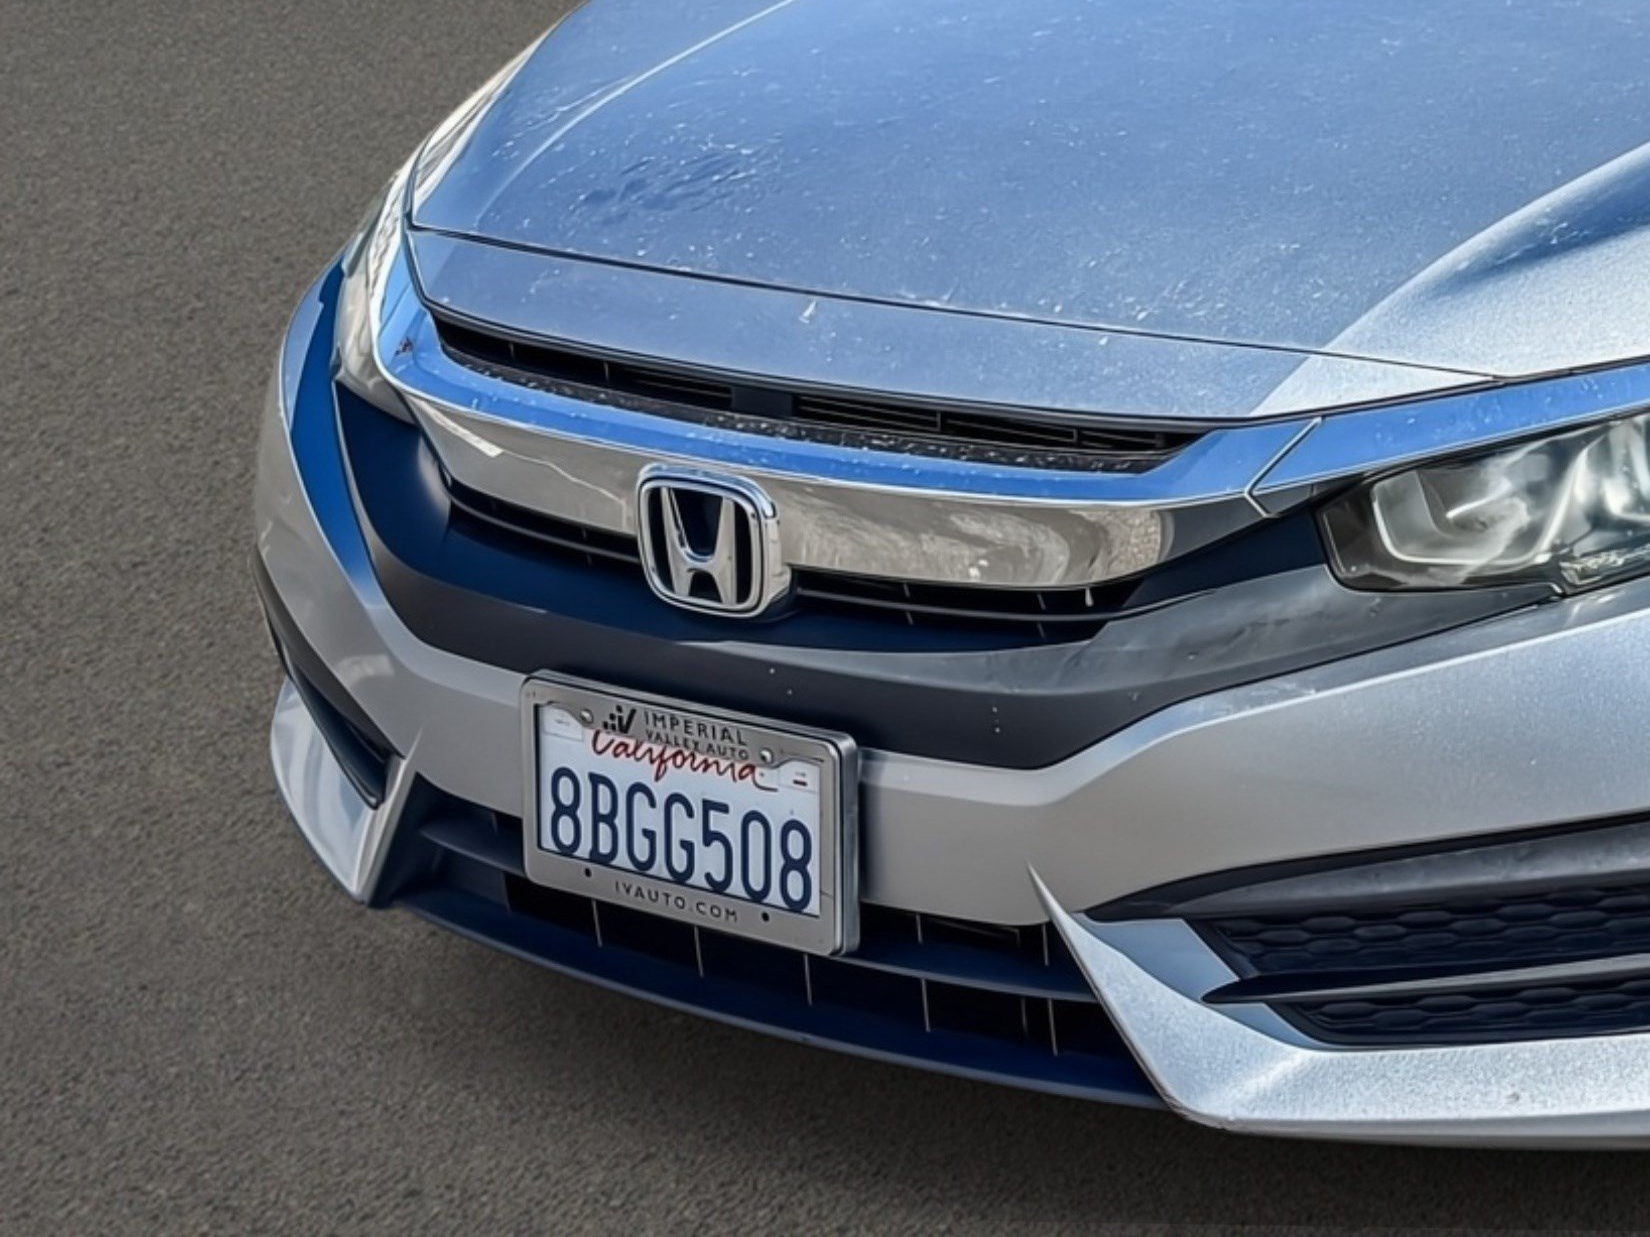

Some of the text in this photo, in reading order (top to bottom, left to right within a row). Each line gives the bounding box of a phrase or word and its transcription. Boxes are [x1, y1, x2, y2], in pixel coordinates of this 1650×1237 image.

[643, 710, 748, 747] IMPERIAL
[645, 729, 750, 761] VALLEY AUTO
[550, 766, 812, 911] 8BGG508
[614, 880, 739, 923] IVAUTO.COM
